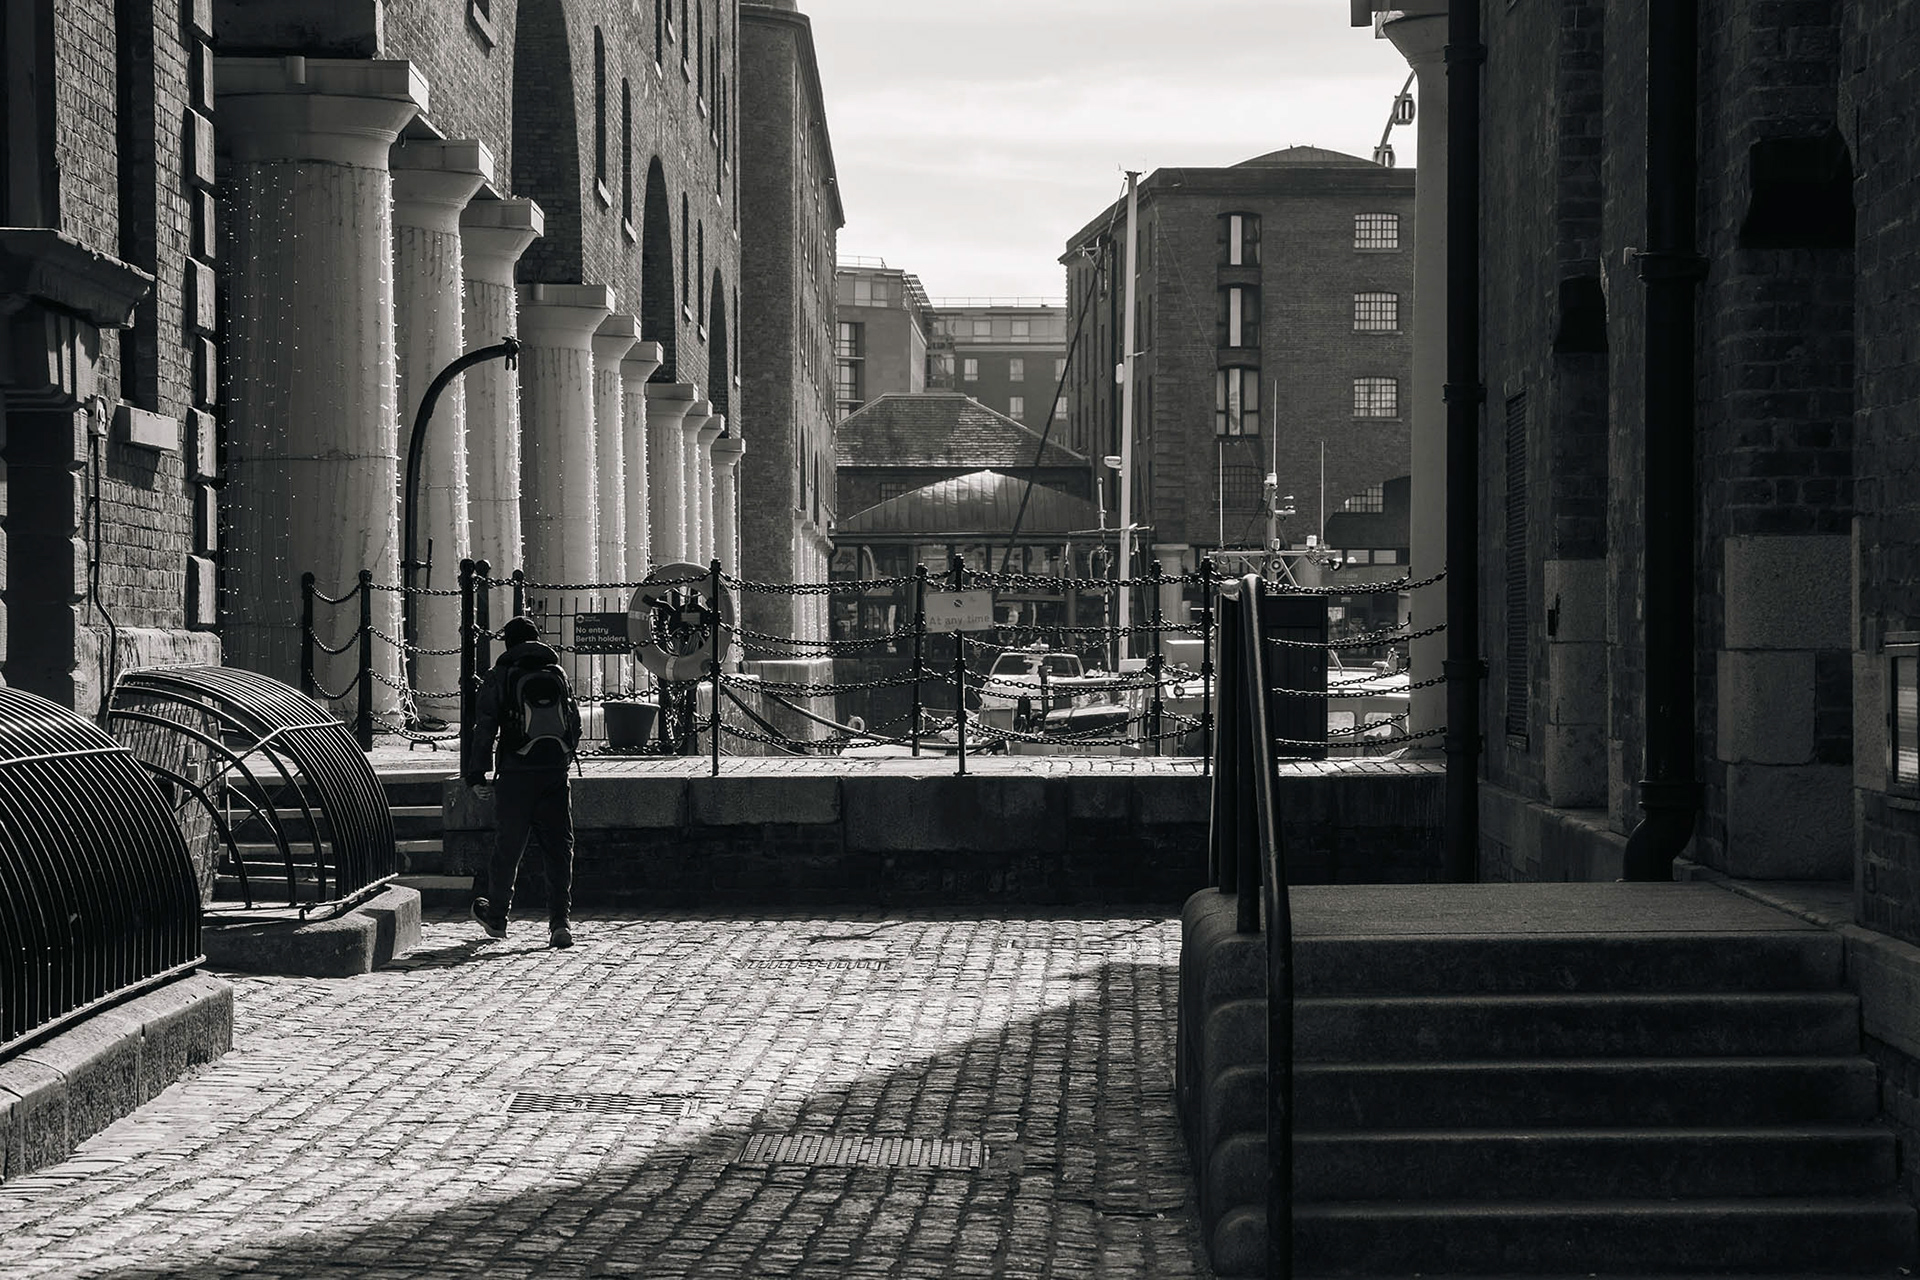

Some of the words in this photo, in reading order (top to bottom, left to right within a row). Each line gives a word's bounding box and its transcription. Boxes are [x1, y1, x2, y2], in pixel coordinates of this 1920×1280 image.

[929, 616, 942, 625] At
[945, 616, 963, 626] any
[967, 614, 990, 624] time
[576, 626, 587, 634] No
[588, 627, 609, 635] entry
